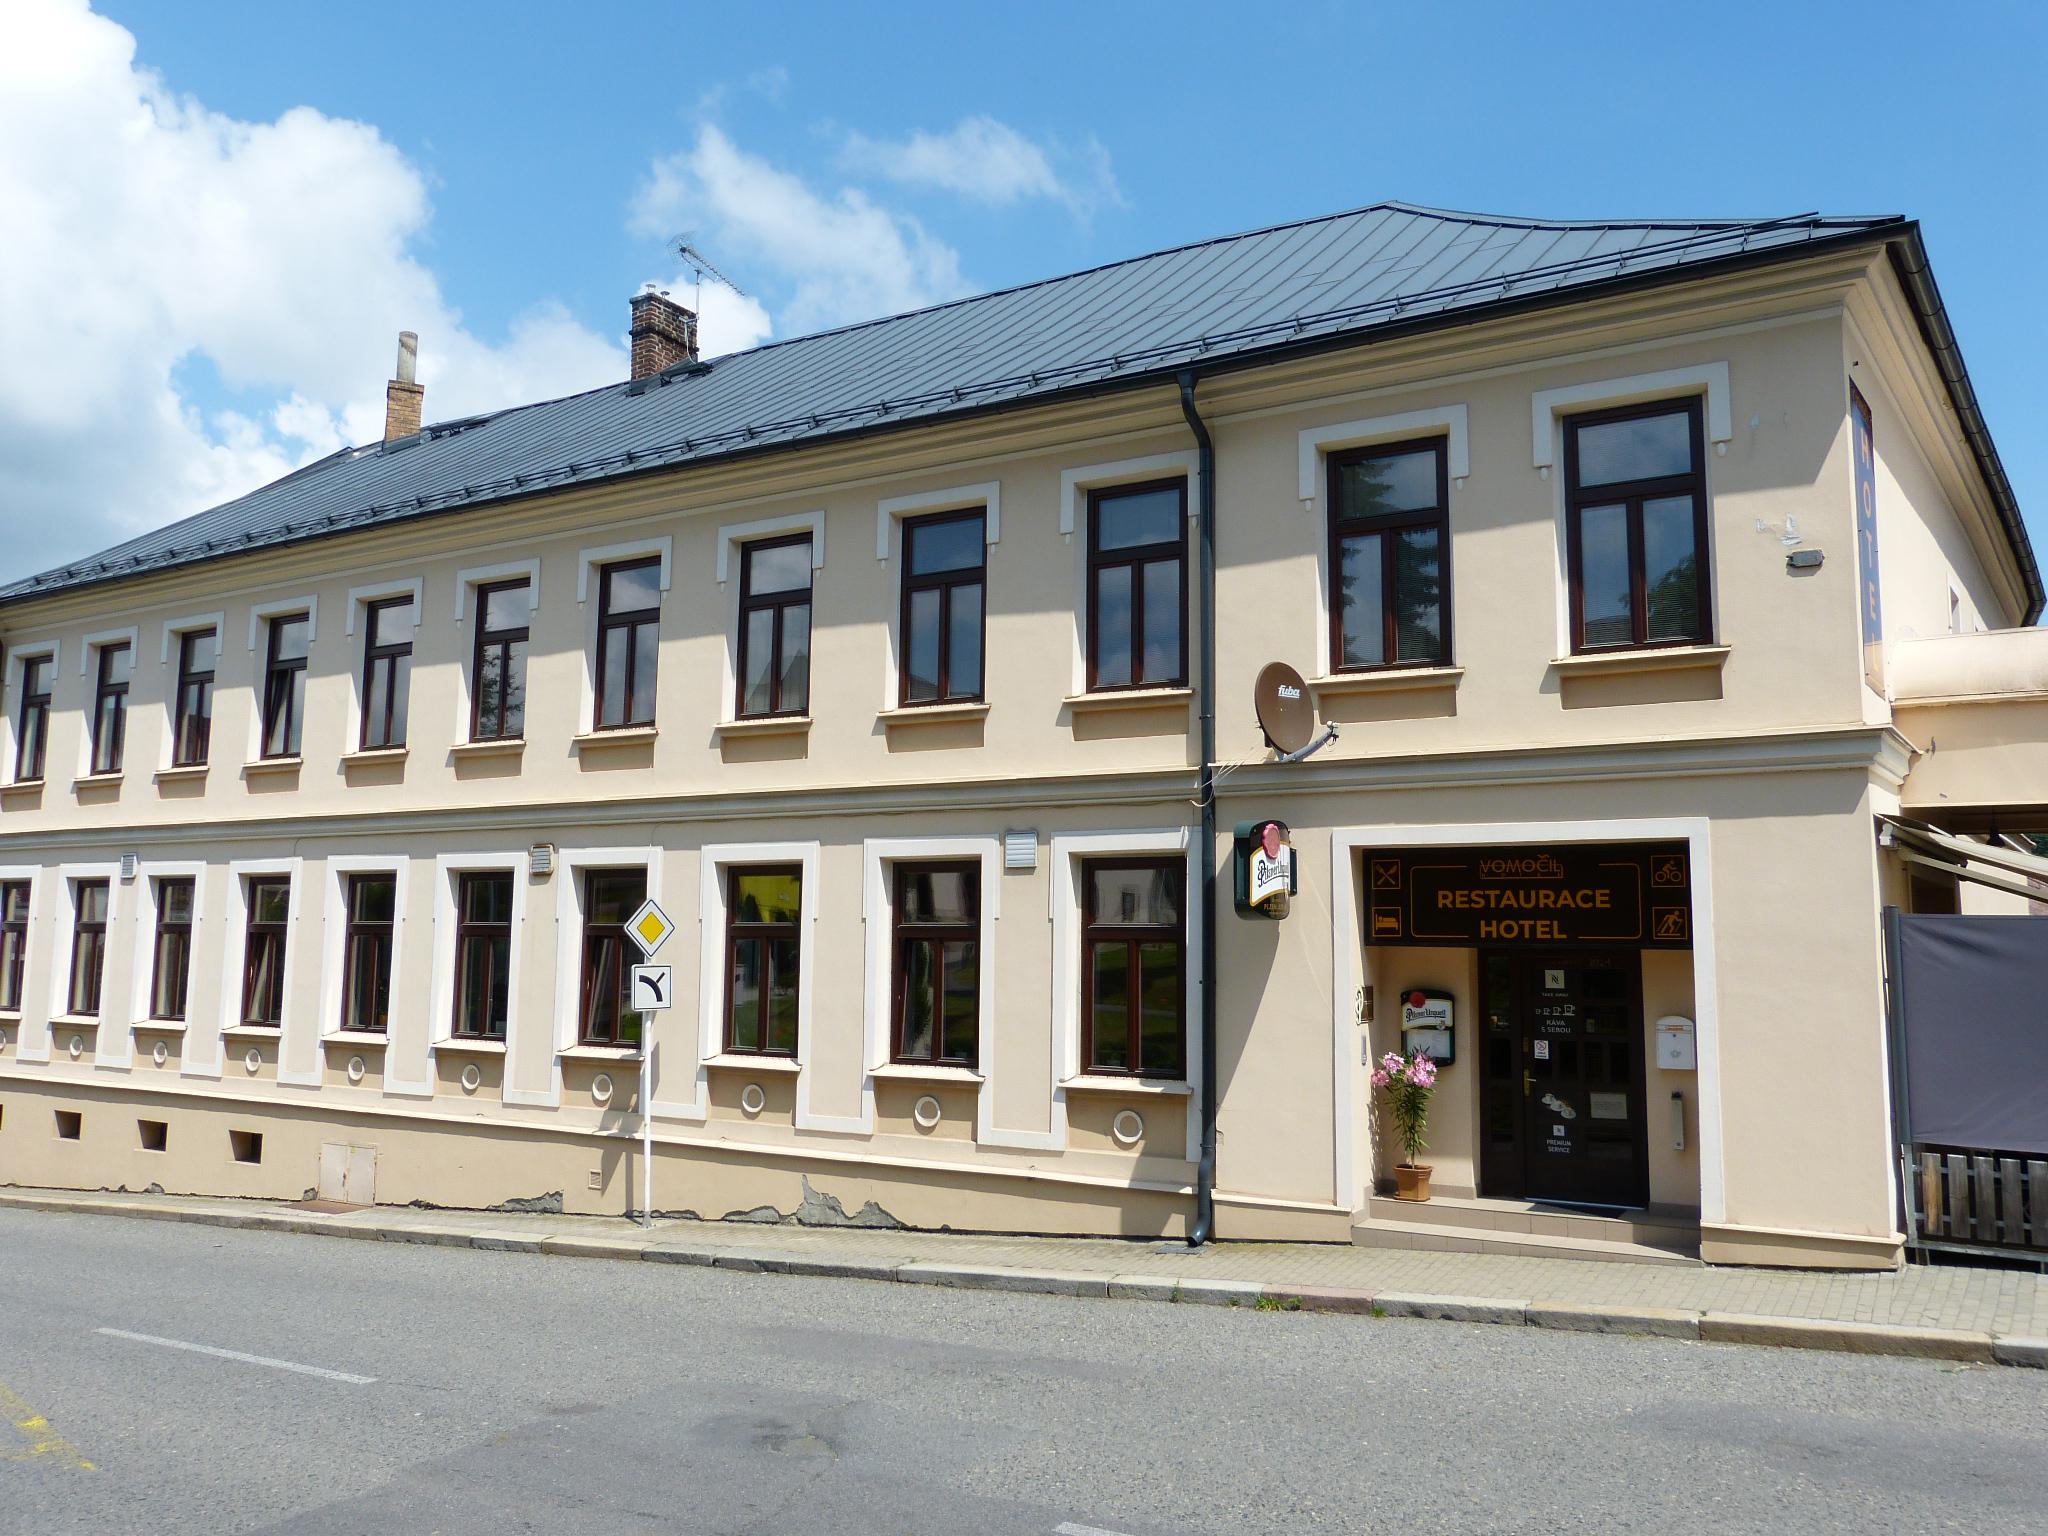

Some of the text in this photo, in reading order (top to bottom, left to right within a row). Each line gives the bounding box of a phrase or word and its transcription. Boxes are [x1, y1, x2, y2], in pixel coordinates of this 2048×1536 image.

[1278, 684, 1300, 699] fuba
[1480, 854, 1561, 873] VOMOČIL
[1257, 859, 1278, 888] Pilsner
[1437, 890, 1611, 909] RESTAURACE
[1480, 919, 1567, 939] HOTEL
